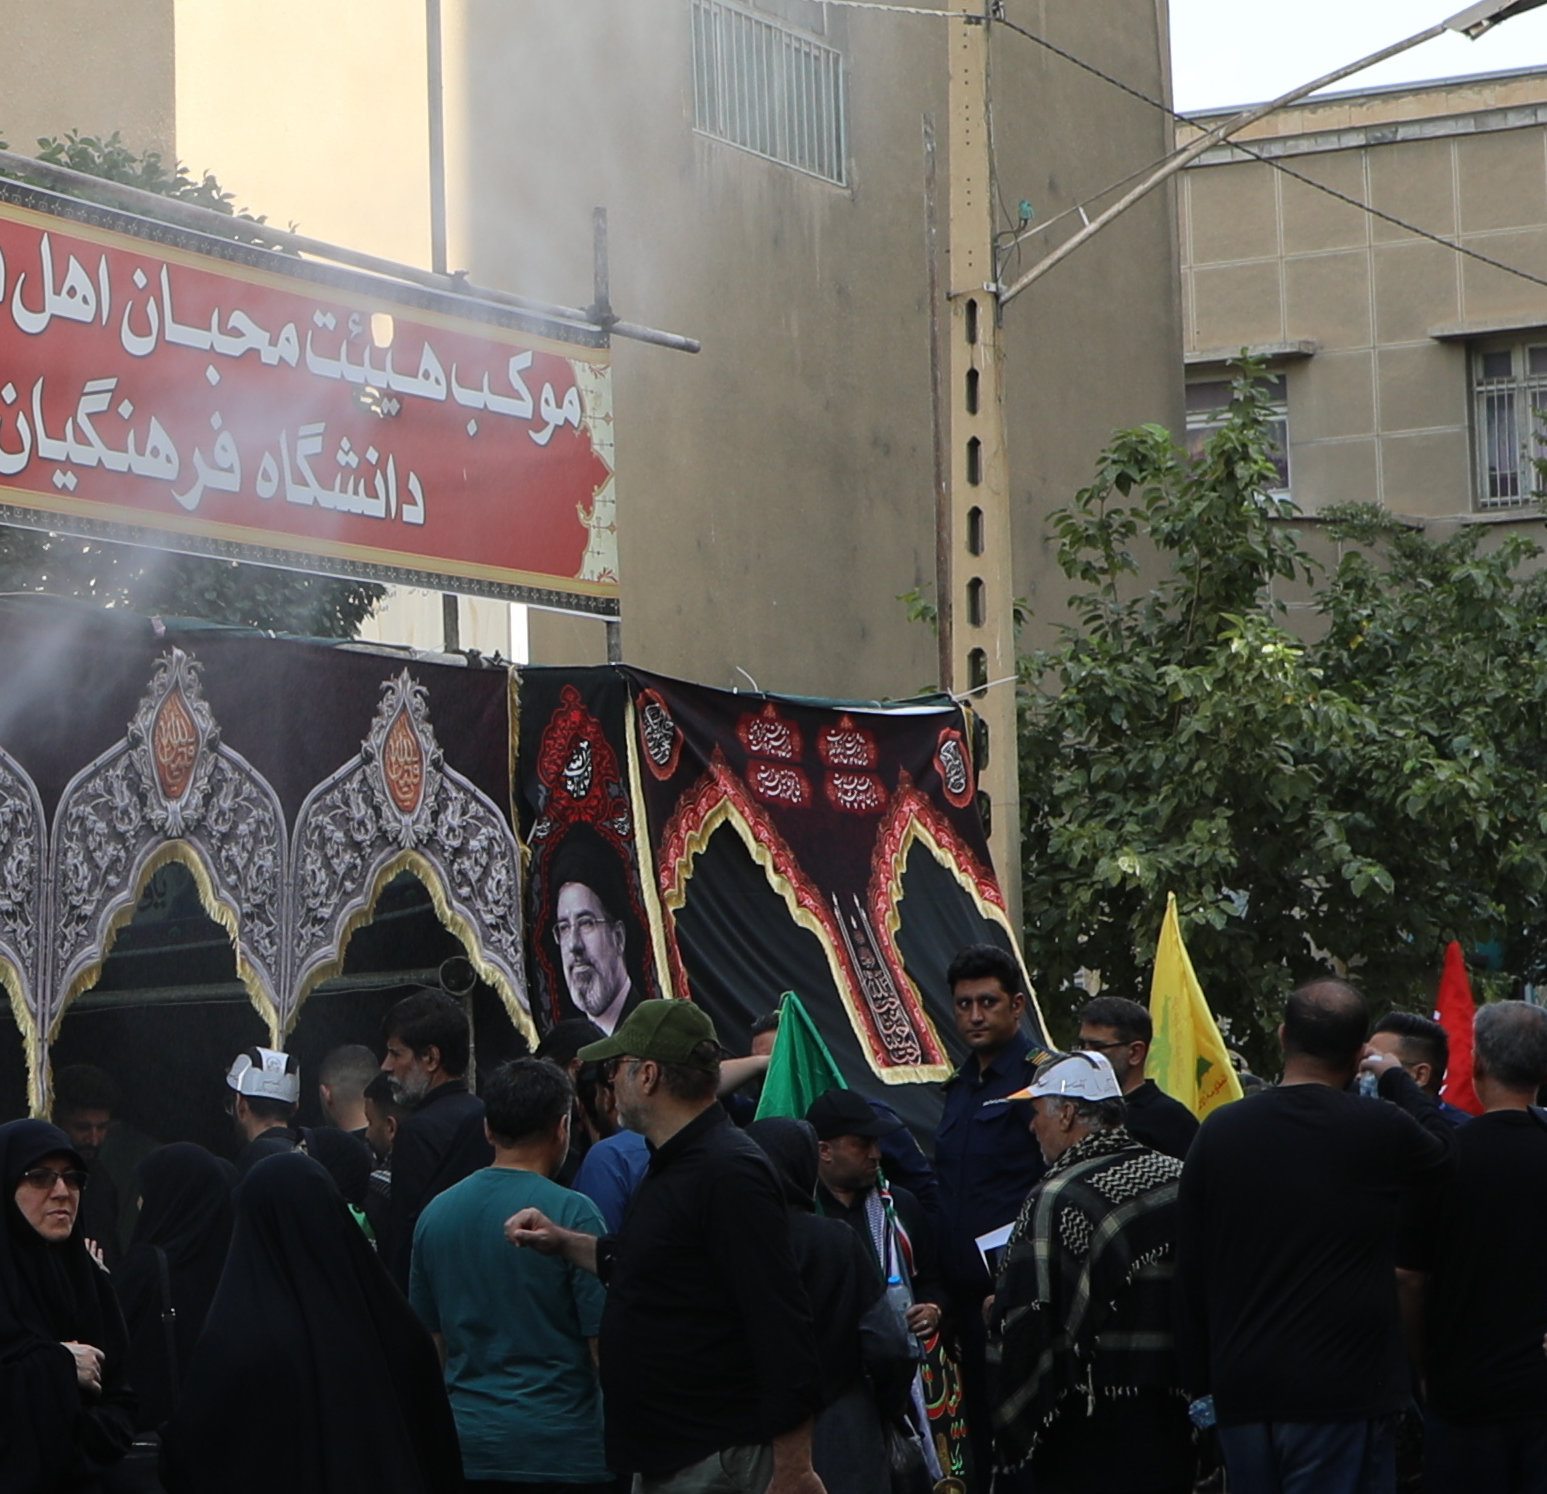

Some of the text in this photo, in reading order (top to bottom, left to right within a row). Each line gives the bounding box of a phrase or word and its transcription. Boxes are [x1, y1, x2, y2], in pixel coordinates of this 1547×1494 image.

[11, 231, 111, 336] اهل
[120, 263, 301, 387] محبان
[451, 351, 583, 446] موکب
[255, 420, 427, 527] دانشگاه
